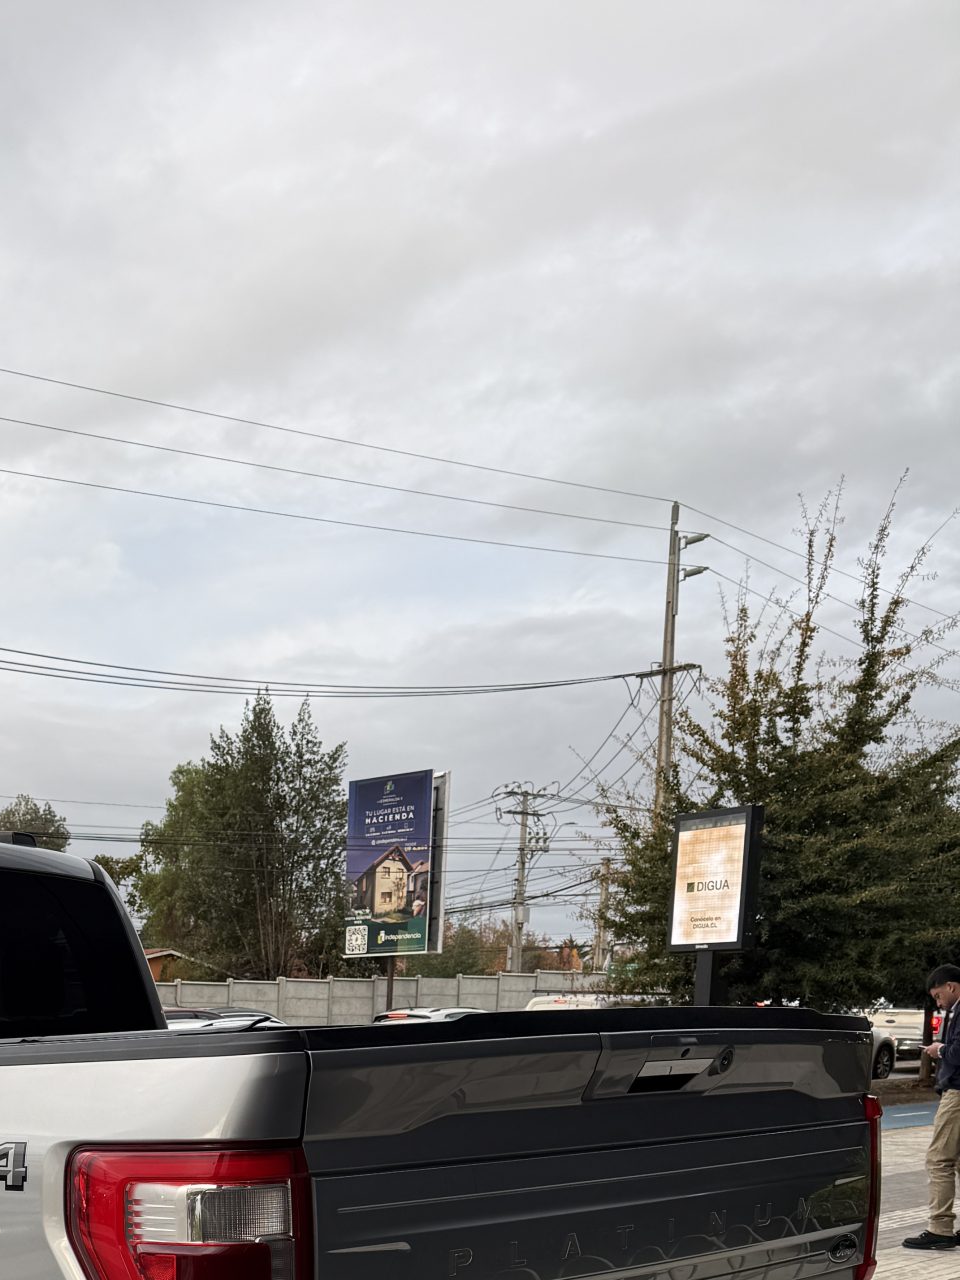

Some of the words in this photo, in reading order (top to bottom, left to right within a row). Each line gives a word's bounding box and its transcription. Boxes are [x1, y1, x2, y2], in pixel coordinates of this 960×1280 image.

[365, 812, 415, 824] HACIENDA
[696, 880, 729, 891] DIGUA
[448, 1196, 813, 1277] PLATINUM
